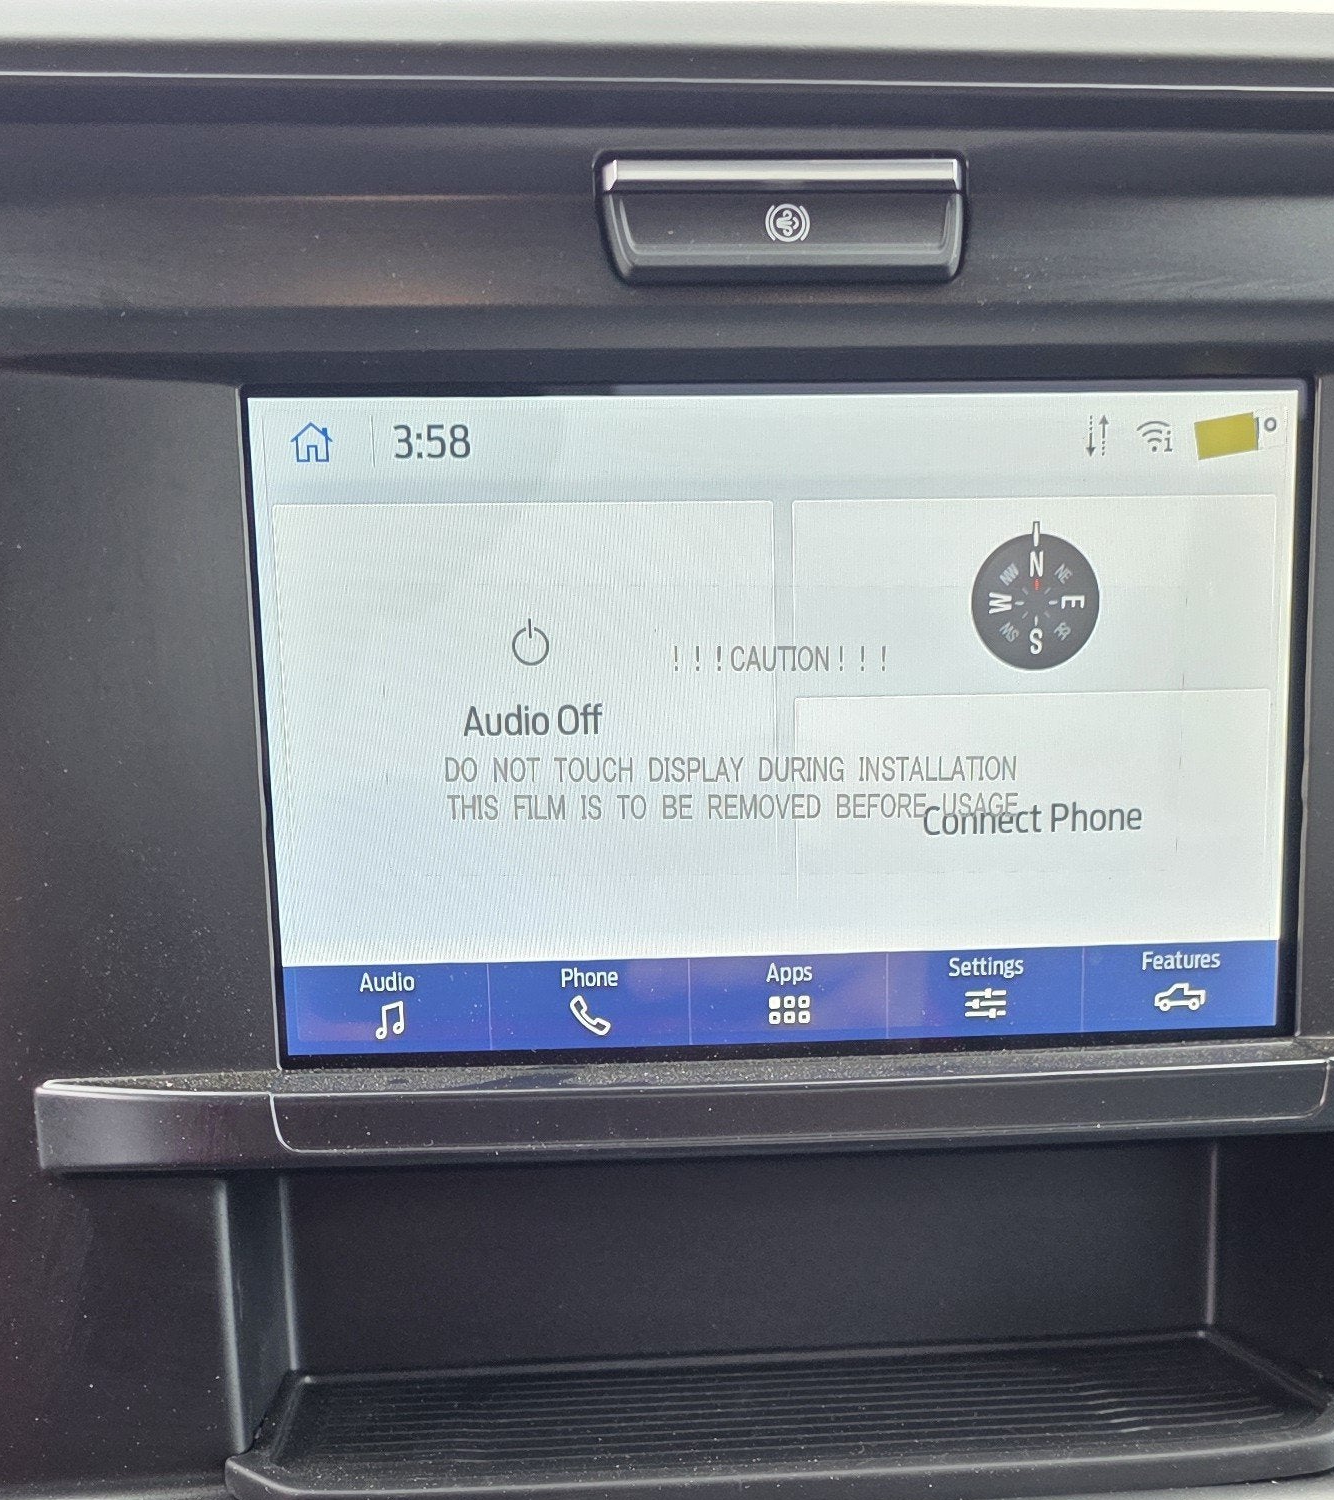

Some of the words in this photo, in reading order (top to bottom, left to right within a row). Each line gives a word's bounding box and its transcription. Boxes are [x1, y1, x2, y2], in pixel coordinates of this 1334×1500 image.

[392, 423, 471, 459] 3:58
[1029, 550, 1044, 578] N
[463, 703, 551, 737] Audio
[557, 702, 604, 736] Off
[443, 756, 479, 783] DO
[492, 756, 542, 783] NOT
[553, 756, 634, 783] TOUCH
[647, 756, 746, 783] DISPLAY
[758, 756, 845, 783] DURING
[857, 755, 1018, 782] INSTALLATION
[447, 794, 500, 821] THIS
[513, 794, 566, 821] FILM
[580, 794, 603, 821] IS
[616, 794, 647, 820] TO
[661, 794, 694, 820] BE
[707, 793, 822, 820] REMOVED
[835, 793, 928, 819] BEFORE
[922, 804, 1043, 837] Connect
[1049, 801, 1143, 833] Phone
[765, 962, 814, 984] Apps
[948, 956, 1025, 979] Settings
[1141, 950, 1222, 971] Features
[359, 972, 416, 993] Audio
[560, 968, 619, 988] Phone
